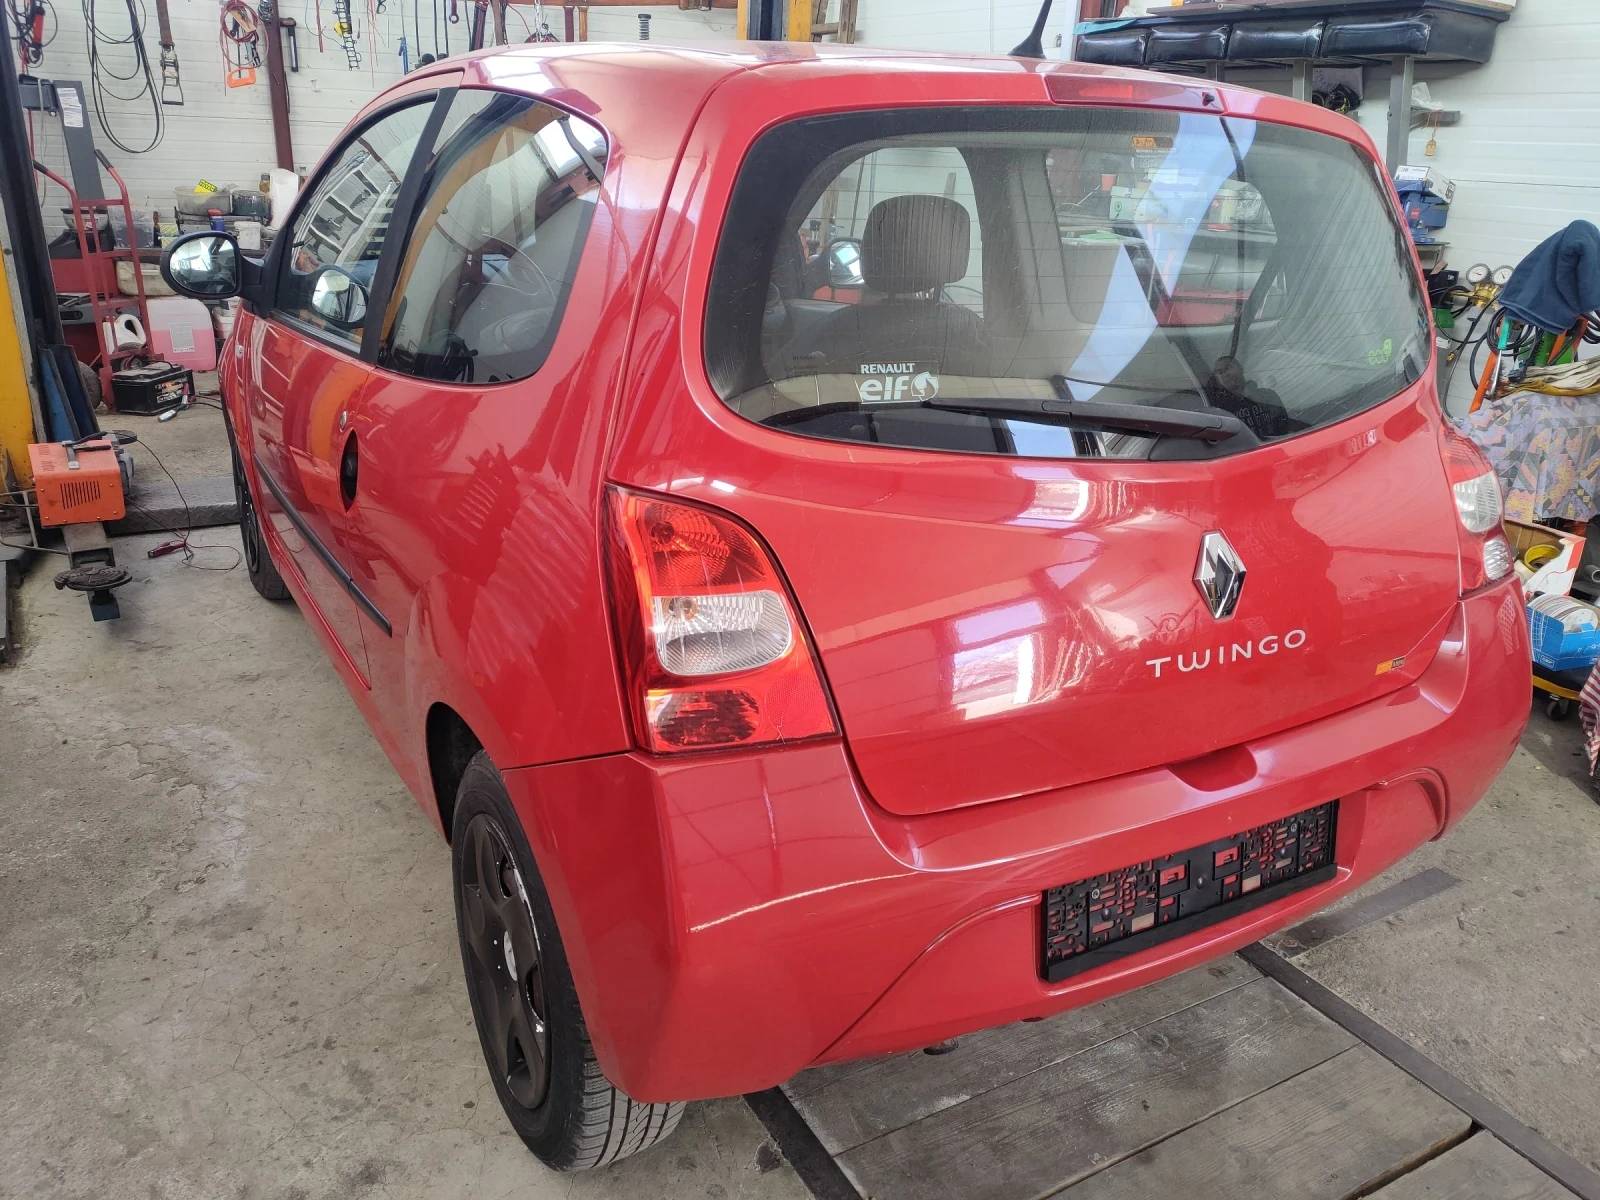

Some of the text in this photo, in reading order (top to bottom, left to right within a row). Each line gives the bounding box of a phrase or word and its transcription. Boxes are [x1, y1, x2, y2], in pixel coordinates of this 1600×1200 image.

[860, 363, 916, 374] RENAULT
[859, 375, 910, 401] elf
[1146, 629, 1307, 678] TWINGO
